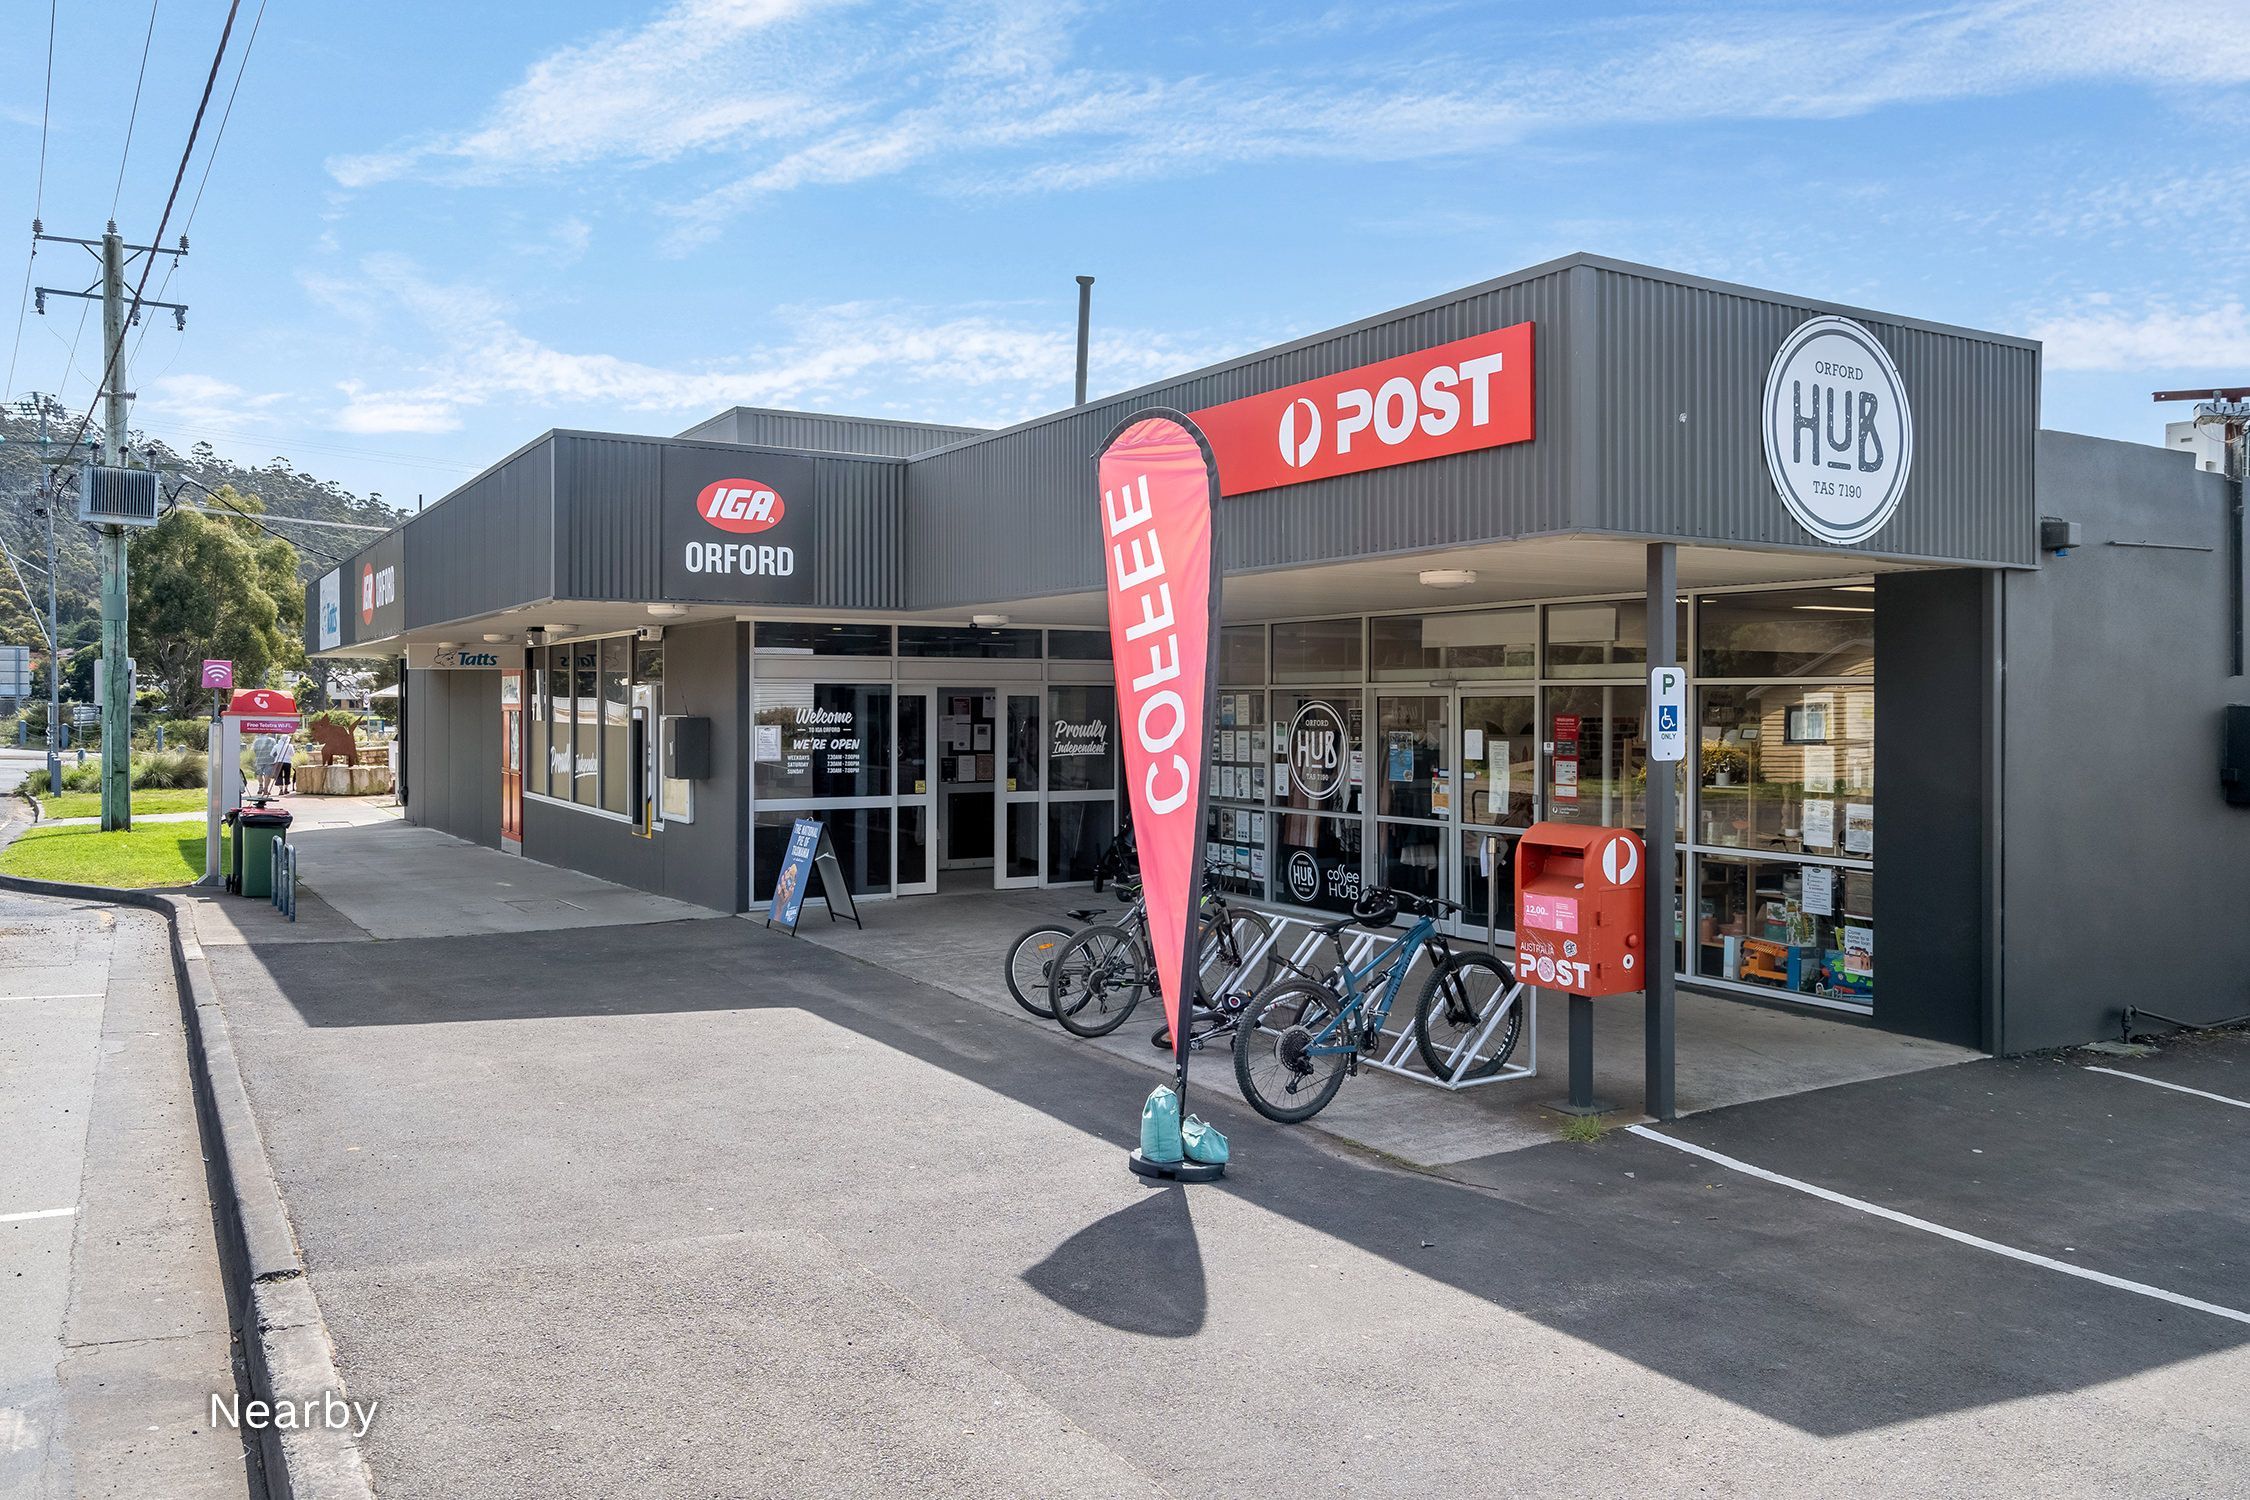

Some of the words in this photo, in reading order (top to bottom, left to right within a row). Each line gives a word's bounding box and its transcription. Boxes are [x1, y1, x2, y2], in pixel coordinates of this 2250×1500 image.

[1815, 360, 1864, 381] ORFORD
[1337, 352, 1502, 455] POST
[1793, 380, 1884, 472] HUB
[1813, 480, 1835, 495] TAS
[1839, 483, 1862, 498] 7190
[706, 487, 775, 521] IGA
[685, 541, 794, 576] ORFORD
[1105, 474, 1190, 815] COFFEE
[458, 651, 499, 666] Tatts
[1663, 673, 1676, 695] P
[795, 707, 852, 724] Welcome
[1305, 719, 1329, 727] ORFORD
[1055, 720, 1107, 742] Proudly
[793, 737, 827, 750] WE'RE
[830, 738, 860, 750] OPEN
[1052, 741, 1108, 755] Independent
[1297, 730, 1338, 769] HUB
[1293, 865, 1314, 886] HUB
[1328, 882, 1359, 900] HUB
[1520, 941, 1555, 955] AUSTRALIA
[1520, 952, 1590, 989] POST
